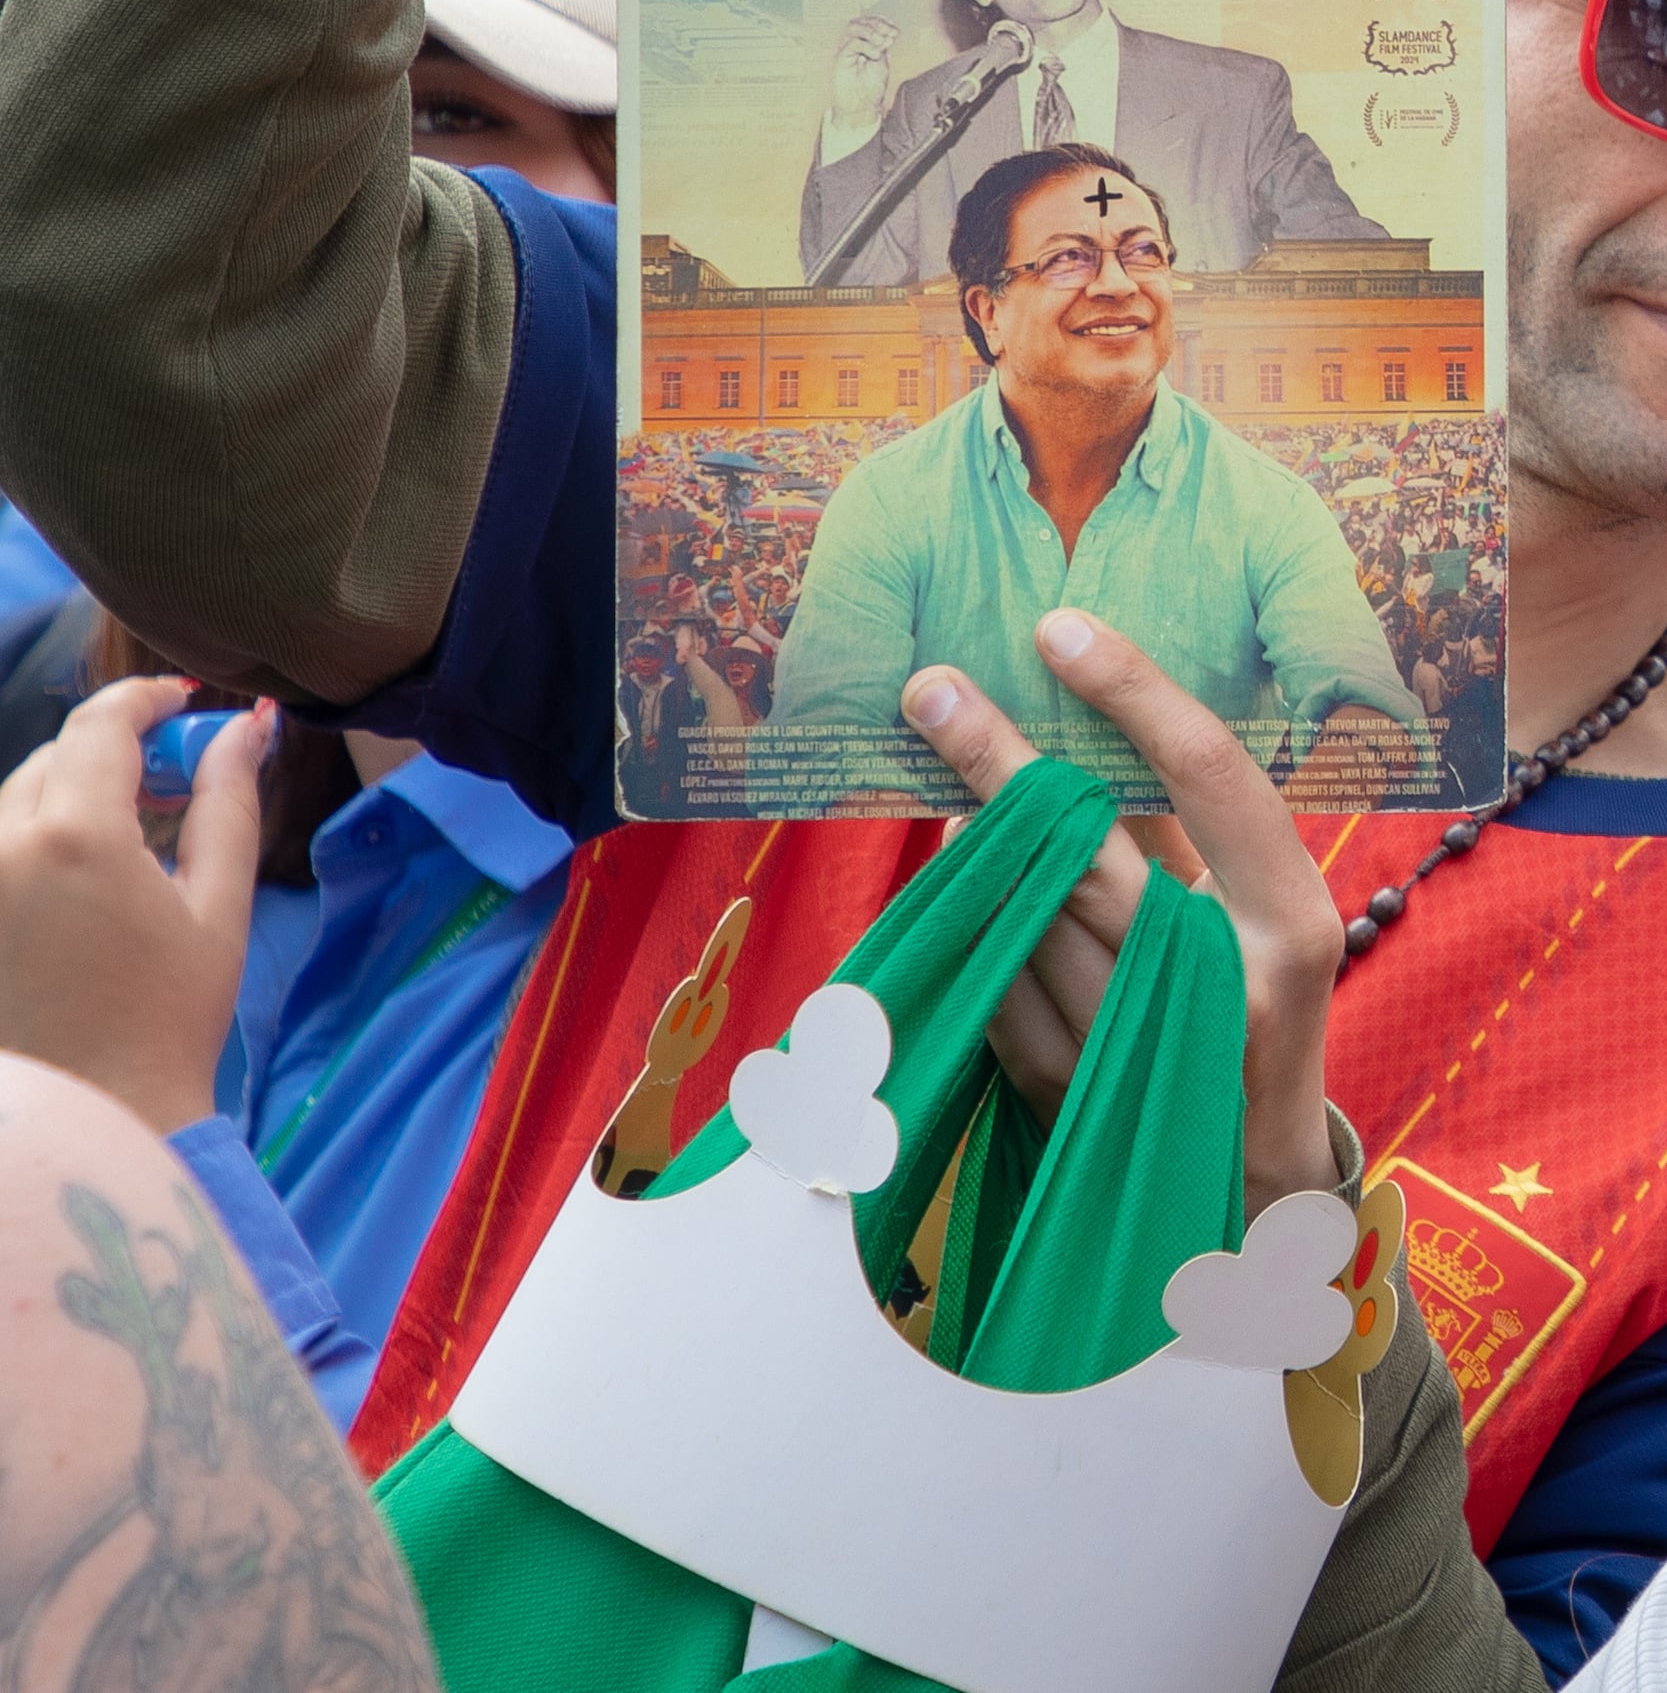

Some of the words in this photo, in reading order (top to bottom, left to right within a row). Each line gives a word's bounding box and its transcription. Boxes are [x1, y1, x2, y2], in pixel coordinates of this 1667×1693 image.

[1378, 30, 1442, 42] SLAMDANCE
[1379, 45, 1399, 54] FILM
[1402, 44, 1441, 54] FESTIVAL
[781, 725, 803, 737] LONG
[832, 724, 859, 736] FILMS
[1226, 721, 1247, 732] SEAN
[1248, 720, 1289, 732] MATTISON
[1325, 719, 1357, 731] TREVOR
[1358, 719, 1390, 730] MARTIN
[1413, 718, 1450, 730] GUSTAVO
[718, 742, 743, 753] DAVID
[774, 741, 796, 753] SEAN
[875, 740, 908, 752] MARTIN
[1246, 736, 1284, 748] GUSTAVO
[1284, 735, 1311, 747] VASCO
[1352, 735, 1376, 747] DAVID
[1377, 735, 1403, 746] ROJAS
[727, 759, 756, 771] DANIEL
[842, 758, 870, 769] EDSON
[1357, 751, 1375, 763] TOM
[1408, 751, 1443, 763] JUANMA
[680, 774, 708, 788] LÓPEZ
[782, 774, 809, 786] MARIE
[900, 772, 928, 785] BLAKE
[1340, 768, 1361, 780] VAYA
[1361, 768, 1387, 779] FILMS
[801, 789, 829, 802] CÉSAR
[943, 789, 965, 800] JUAN
[1292, 785, 1328, 797] ROBERTS
[1366, 783, 1401, 795] DUNCAN
[1402, 783, 1441, 795] SULLIVAN
[1306, 800, 1341, 812] ROGELIO
[1341, 797, 1373, 811] GARCÍA
